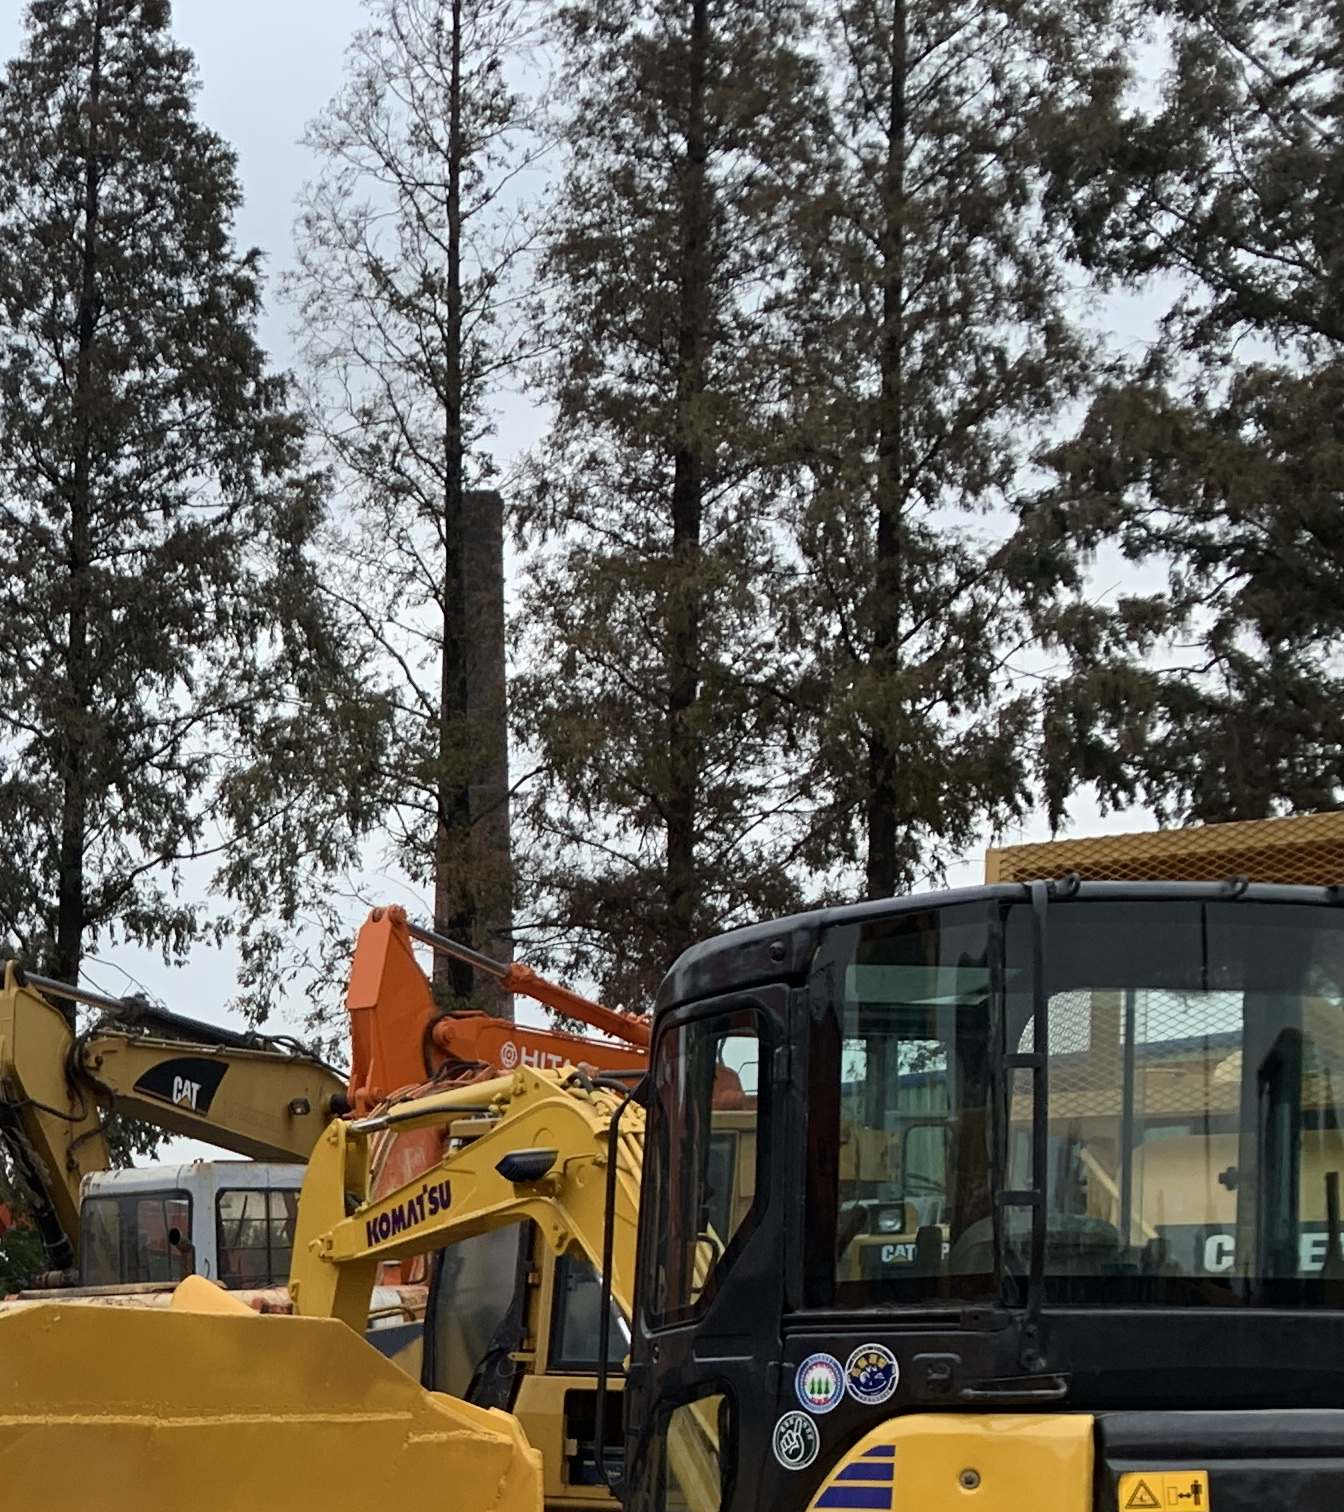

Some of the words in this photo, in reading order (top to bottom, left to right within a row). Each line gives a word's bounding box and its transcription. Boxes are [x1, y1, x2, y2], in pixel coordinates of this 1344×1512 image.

[173, 1075, 202, 1112] CAT
[366, 1179, 452, 1247] KOMATSU
[881, 1243, 916, 1263] CAT
